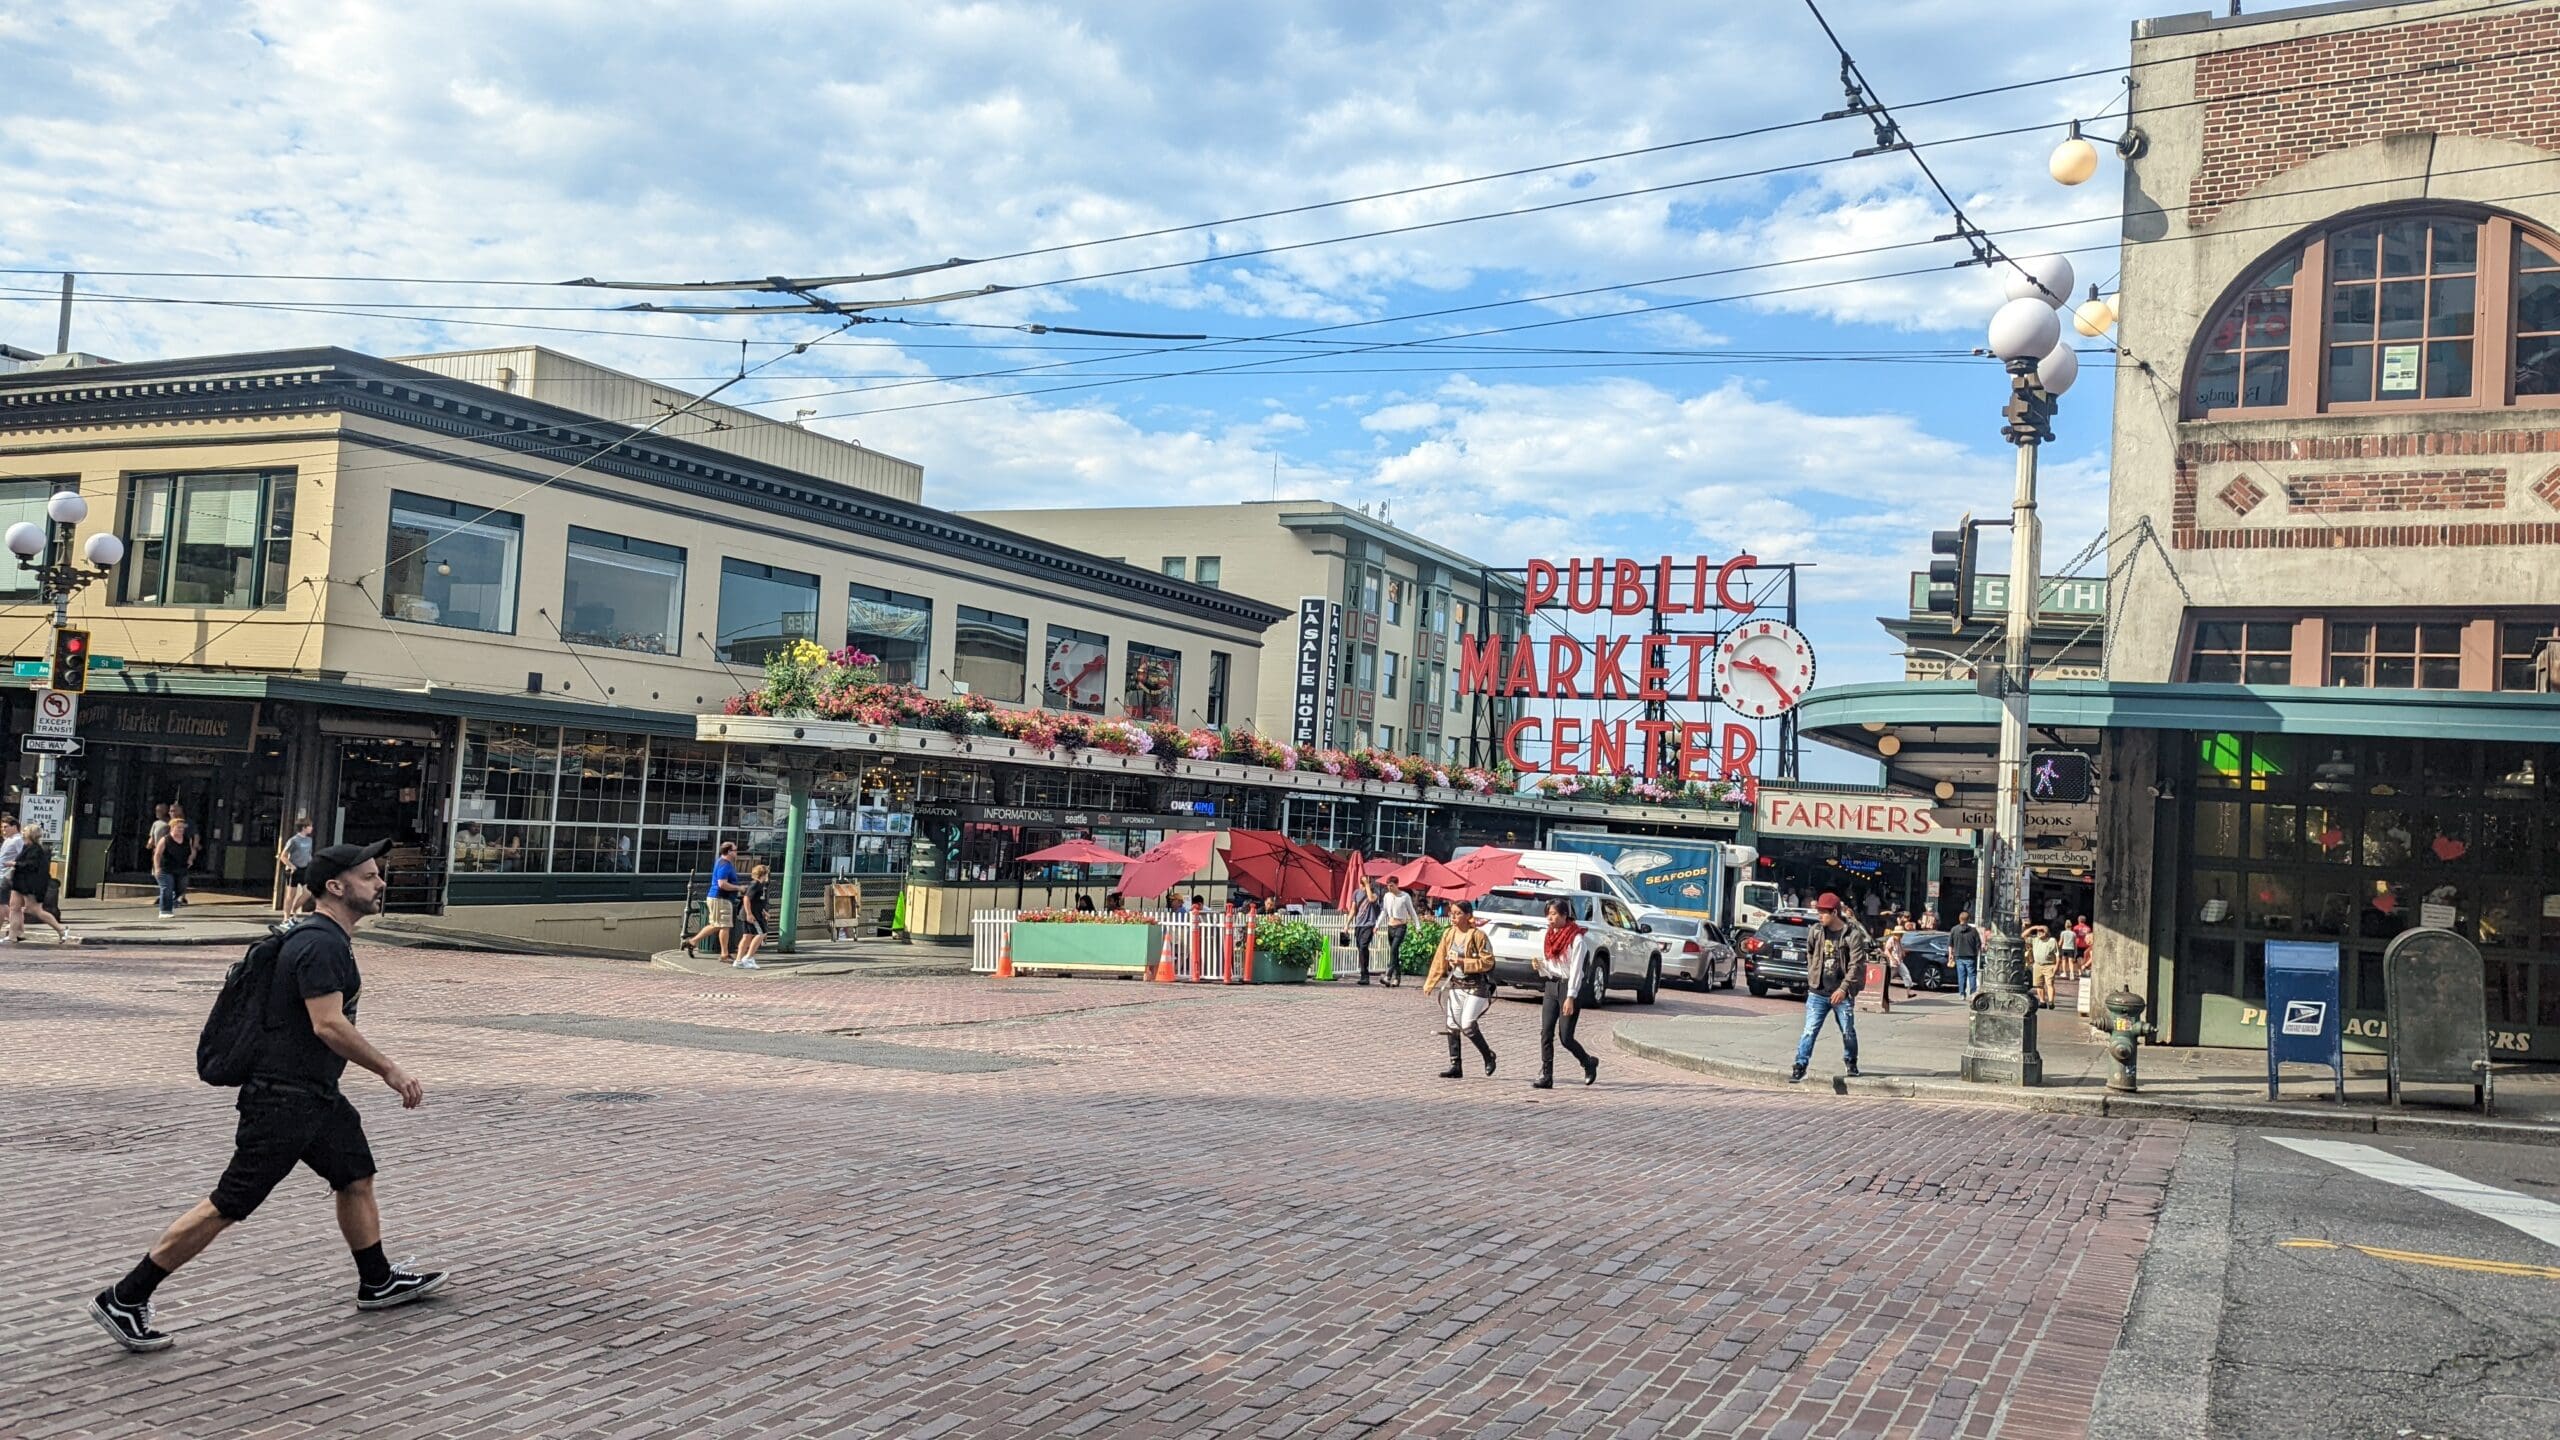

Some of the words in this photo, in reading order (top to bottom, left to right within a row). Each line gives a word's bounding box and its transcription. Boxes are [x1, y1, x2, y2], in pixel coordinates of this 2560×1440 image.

[1525, 555, 1757, 615] PUBLIC
[2050, 583, 2107, 610] TH
[1304, 602, 1320, 625] LA
[1331, 605, 1339, 628] LA
[1739, 629, 1748, 639] 11
[1759, 624, 1770, 634] 12
[1783, 629, 1787, 639] 1
[1724, 643, 1734, 653] 10
[1796, 644, 1803, 655] 2
[1301, 628, 1319, 686] SALLE
[1327, 634, 1338, 690] SALLE
[1459, 633, 1716, 700] MARKET
[1718, 664, 1725, 673] 9
[1800, 664, 1808, 676] 3
[1736, 699, 1744, 709] 7
[117, 706, 160, 733] Market
[166, 709, 228, 737] Entrance
[1503, 716, 1757, 780] CENTER
[983, 808, 1042, 820] INFORMATION
[1121, 816, 1155, 824] INFORMATION
[1771, 799, 1931, 834] FARMERS
[2026, 850, 2058, 863] rumpet
[2061, 850, 2088, 863] Shop
[1645, 867, 1708, 885] SEAFOODS
